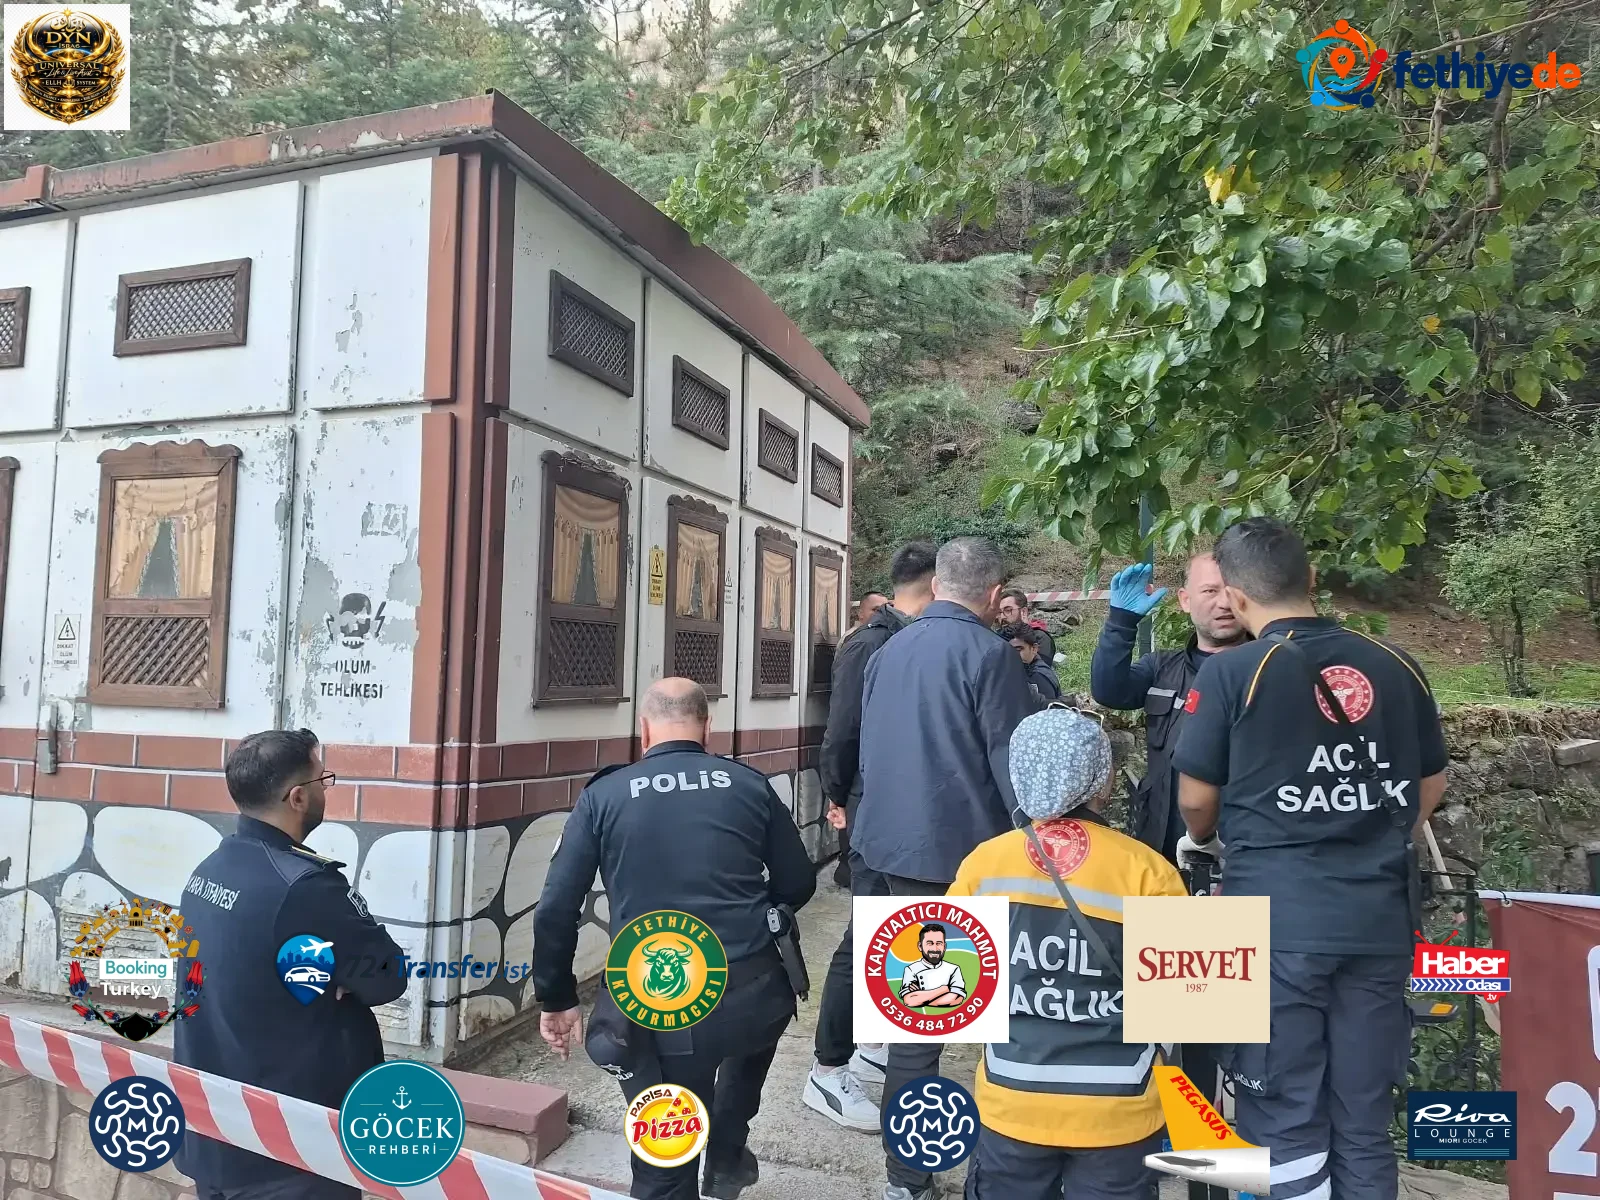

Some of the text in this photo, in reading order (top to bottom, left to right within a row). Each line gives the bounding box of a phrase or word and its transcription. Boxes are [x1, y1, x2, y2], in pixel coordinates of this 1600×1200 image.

[1306, 735, 1391, 773] ACL
[1276, 776, 1411, 813] SAĞLK
[1009, 928, 1103, 977] ACİL
[1009, 977, 1123, 1022] AĞLIK
[1544, 1081, 1600, 1178] 2
